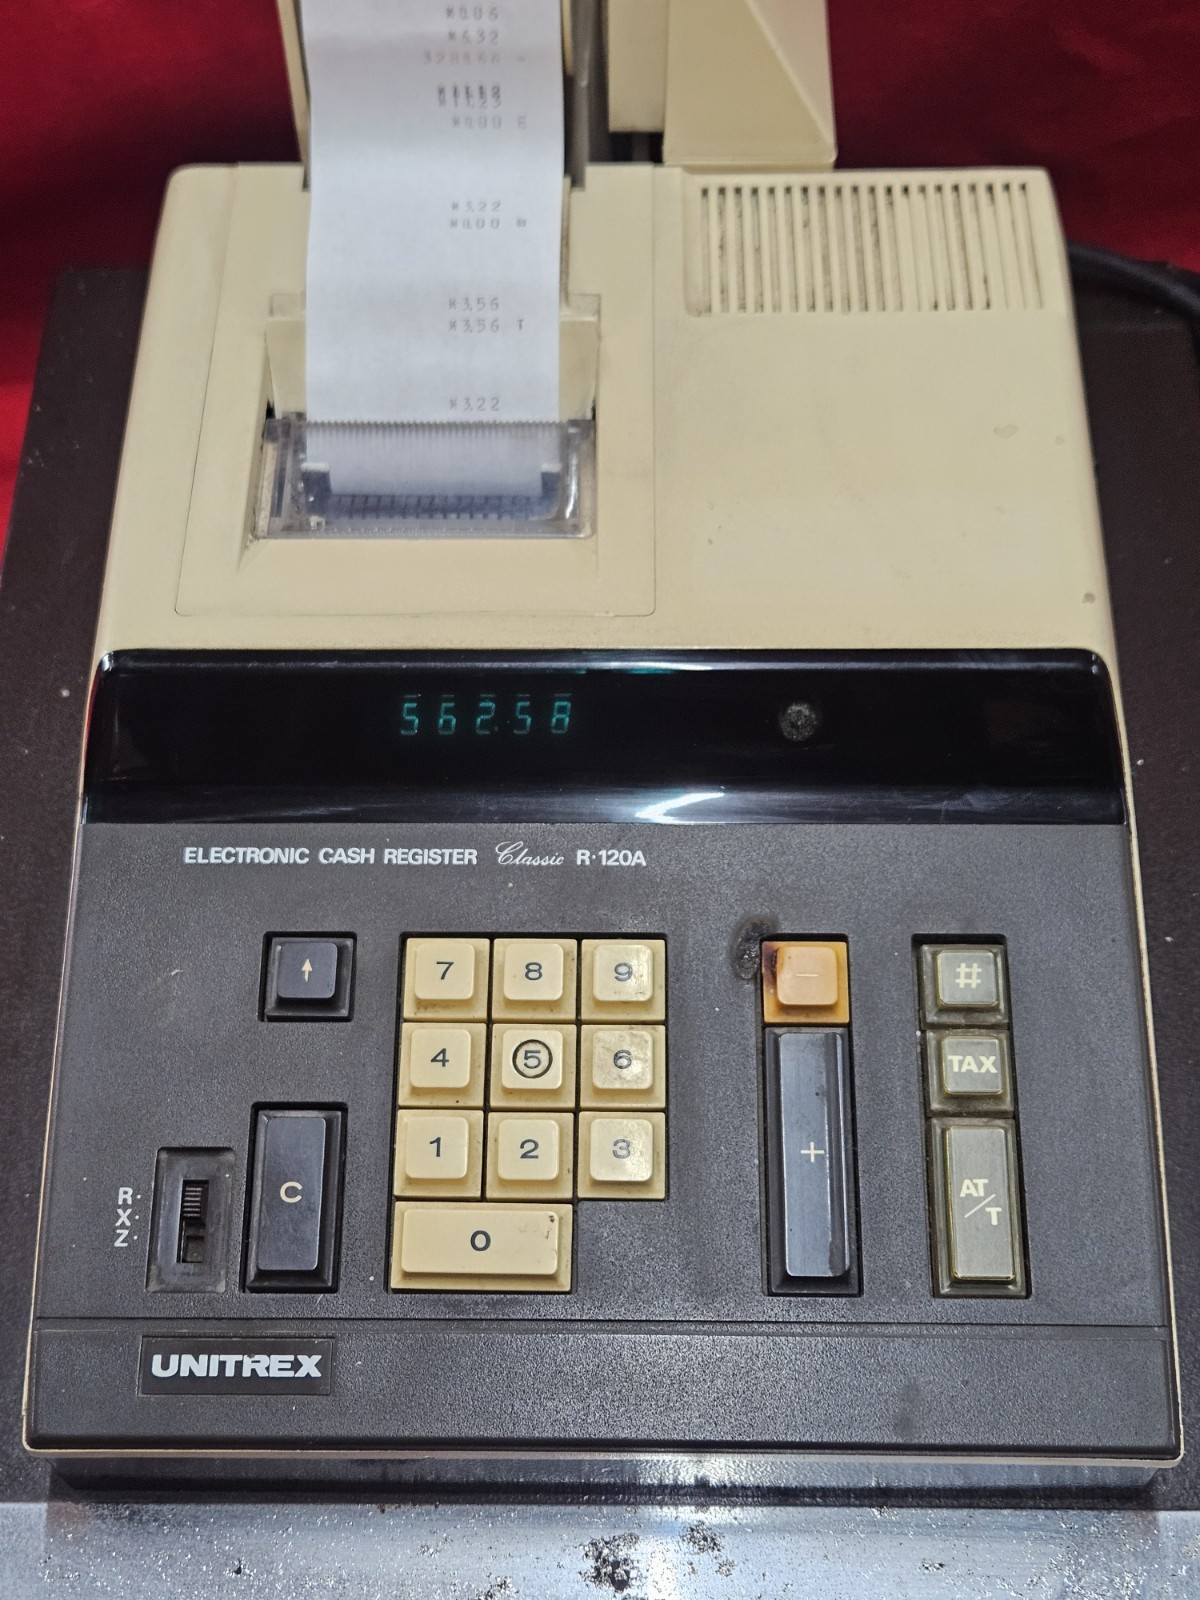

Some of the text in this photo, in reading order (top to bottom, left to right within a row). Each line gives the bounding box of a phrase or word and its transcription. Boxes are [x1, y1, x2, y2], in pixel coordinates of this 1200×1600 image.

[184, 846, 309, 865] ELECTRONIC
[318, 847, 376, 865] CASH
[383, 847, 478, 865] REGISTER
[495, 841, 565, 866] Classic
[436, 961, 455, 981] 7
[524, 961, 543, 981] 8
[613, 961, 633, 982] 9
[430, 1047, 450, 1068] 4
[613, 1049, 632, 1070] 6
[948, 1055, 998, 1073] TAX
[429, 1136, 442, 1158] 1
[519, 1138, 540, 1160] 2
[612, 1138, 631, 1159] 3
[117, 1186, 134, 1205] R
[279, 1181, 303, 1203] C
[114, 1208, 132, 1227] X
[113, 1229, 129, 1247] Z
[151, 1354, 322, 1378] UNITREX
